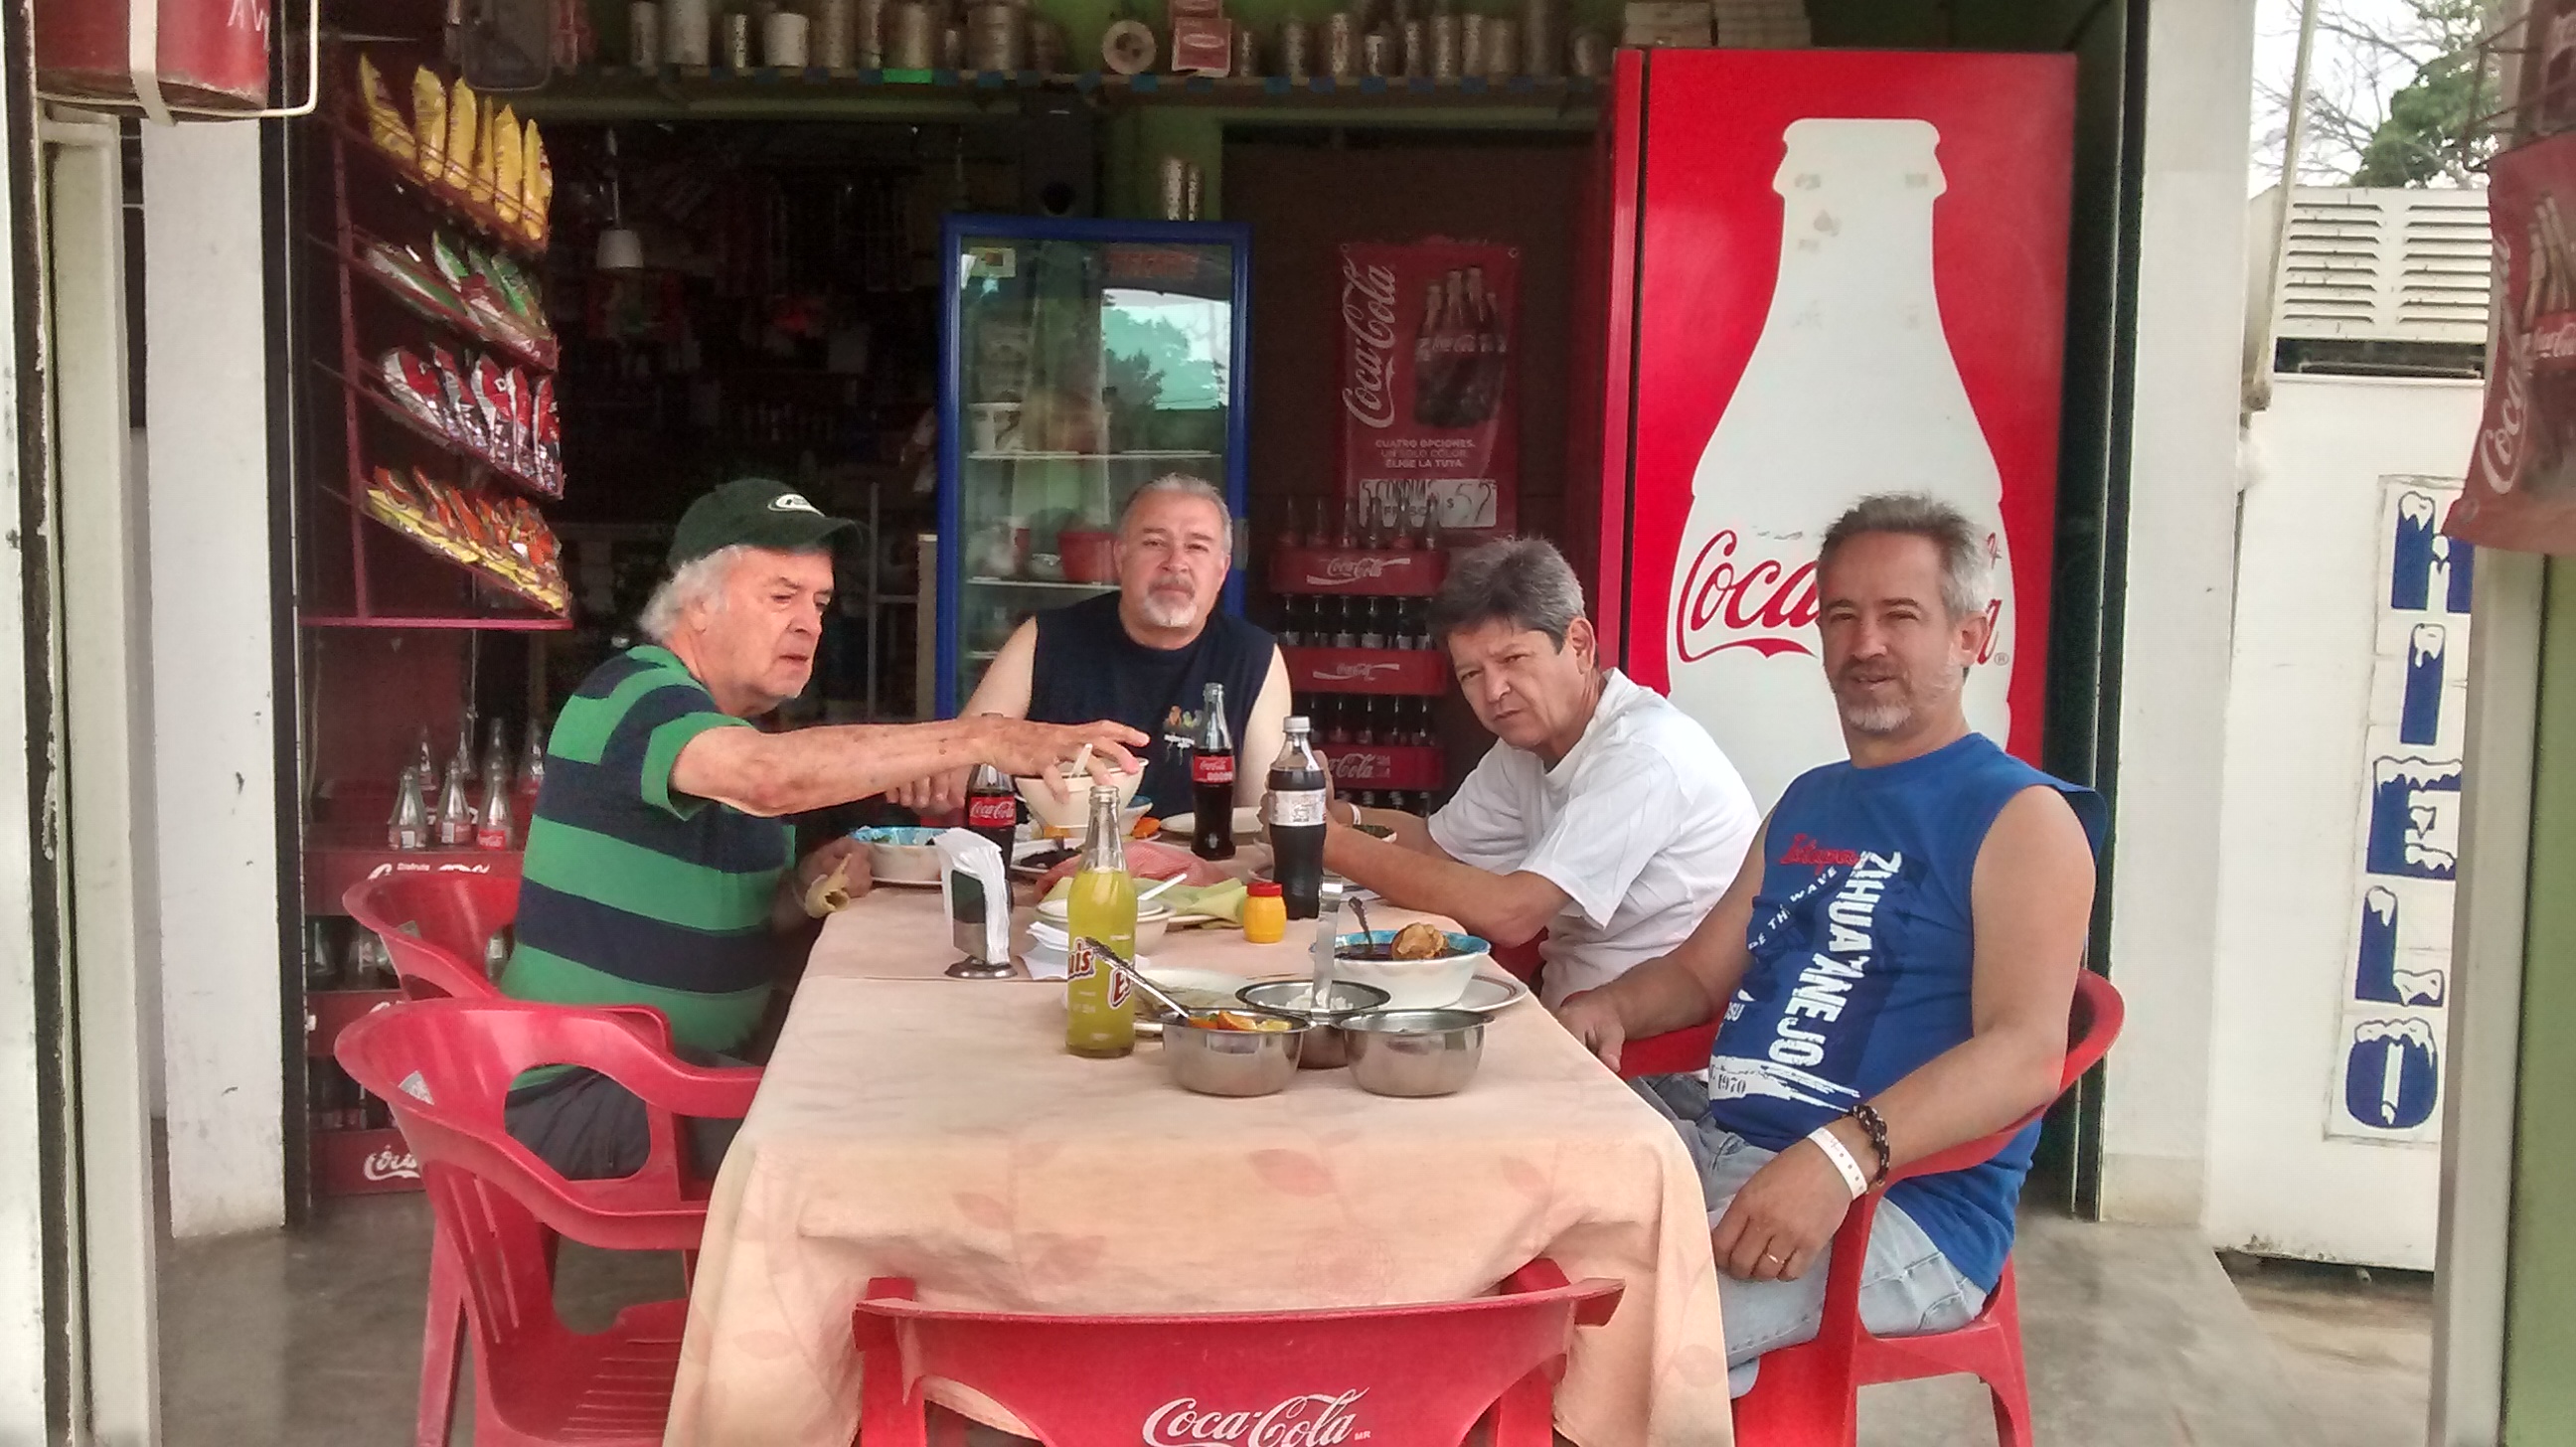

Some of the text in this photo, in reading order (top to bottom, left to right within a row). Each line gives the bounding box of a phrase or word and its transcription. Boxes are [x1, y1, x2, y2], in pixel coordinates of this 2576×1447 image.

[1342, 253, 1396, 428] Coca-Cola
[1375, 439, 1418, 448] CUATRO
[1418, 459, 1432, 468] LA
[970, 800, 1015, 819] Coca-Cola
[2344, 491, 2475, 1134] HIELO
[1790, 866, 1838, 902] WAVE
[1717, 1073, 1747, 1094] 1970
[1142, 1386, 1370, 1447] Coca-Cola
